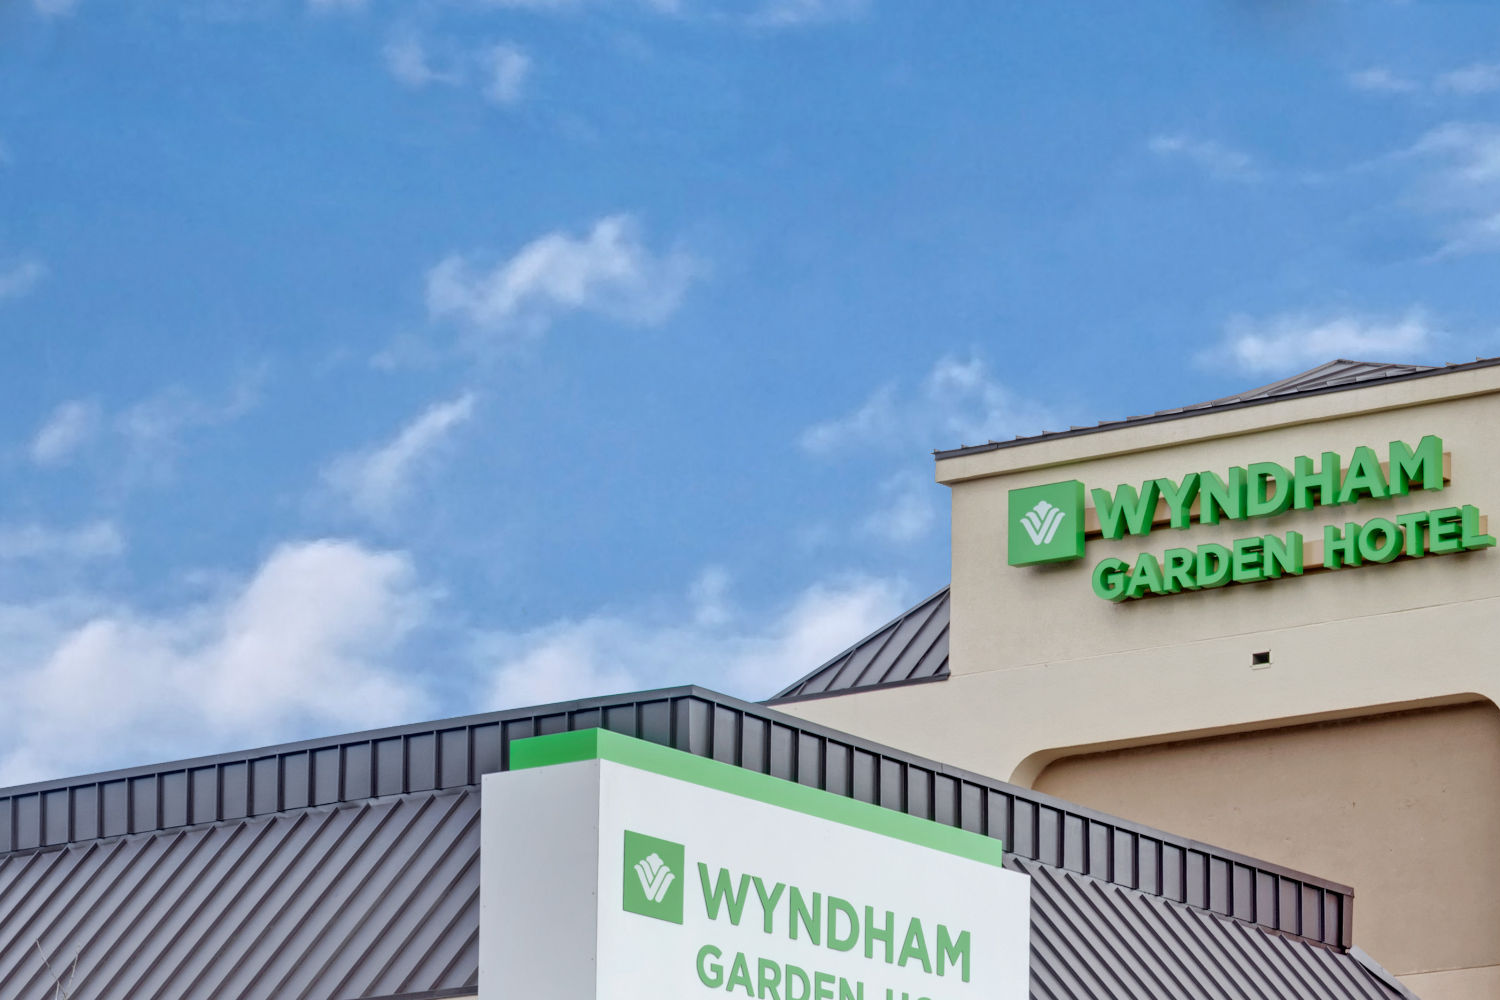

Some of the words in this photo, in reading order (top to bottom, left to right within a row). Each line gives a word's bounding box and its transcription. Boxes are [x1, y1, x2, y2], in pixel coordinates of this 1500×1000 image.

[1091, 435, 1444, 541] WYNDHAM
[1092, 531, 1304, 602] GARDEN
[1323, 504, 1496, 569] HOTEL
[697, 862, 971, 982] WYNDHAM
